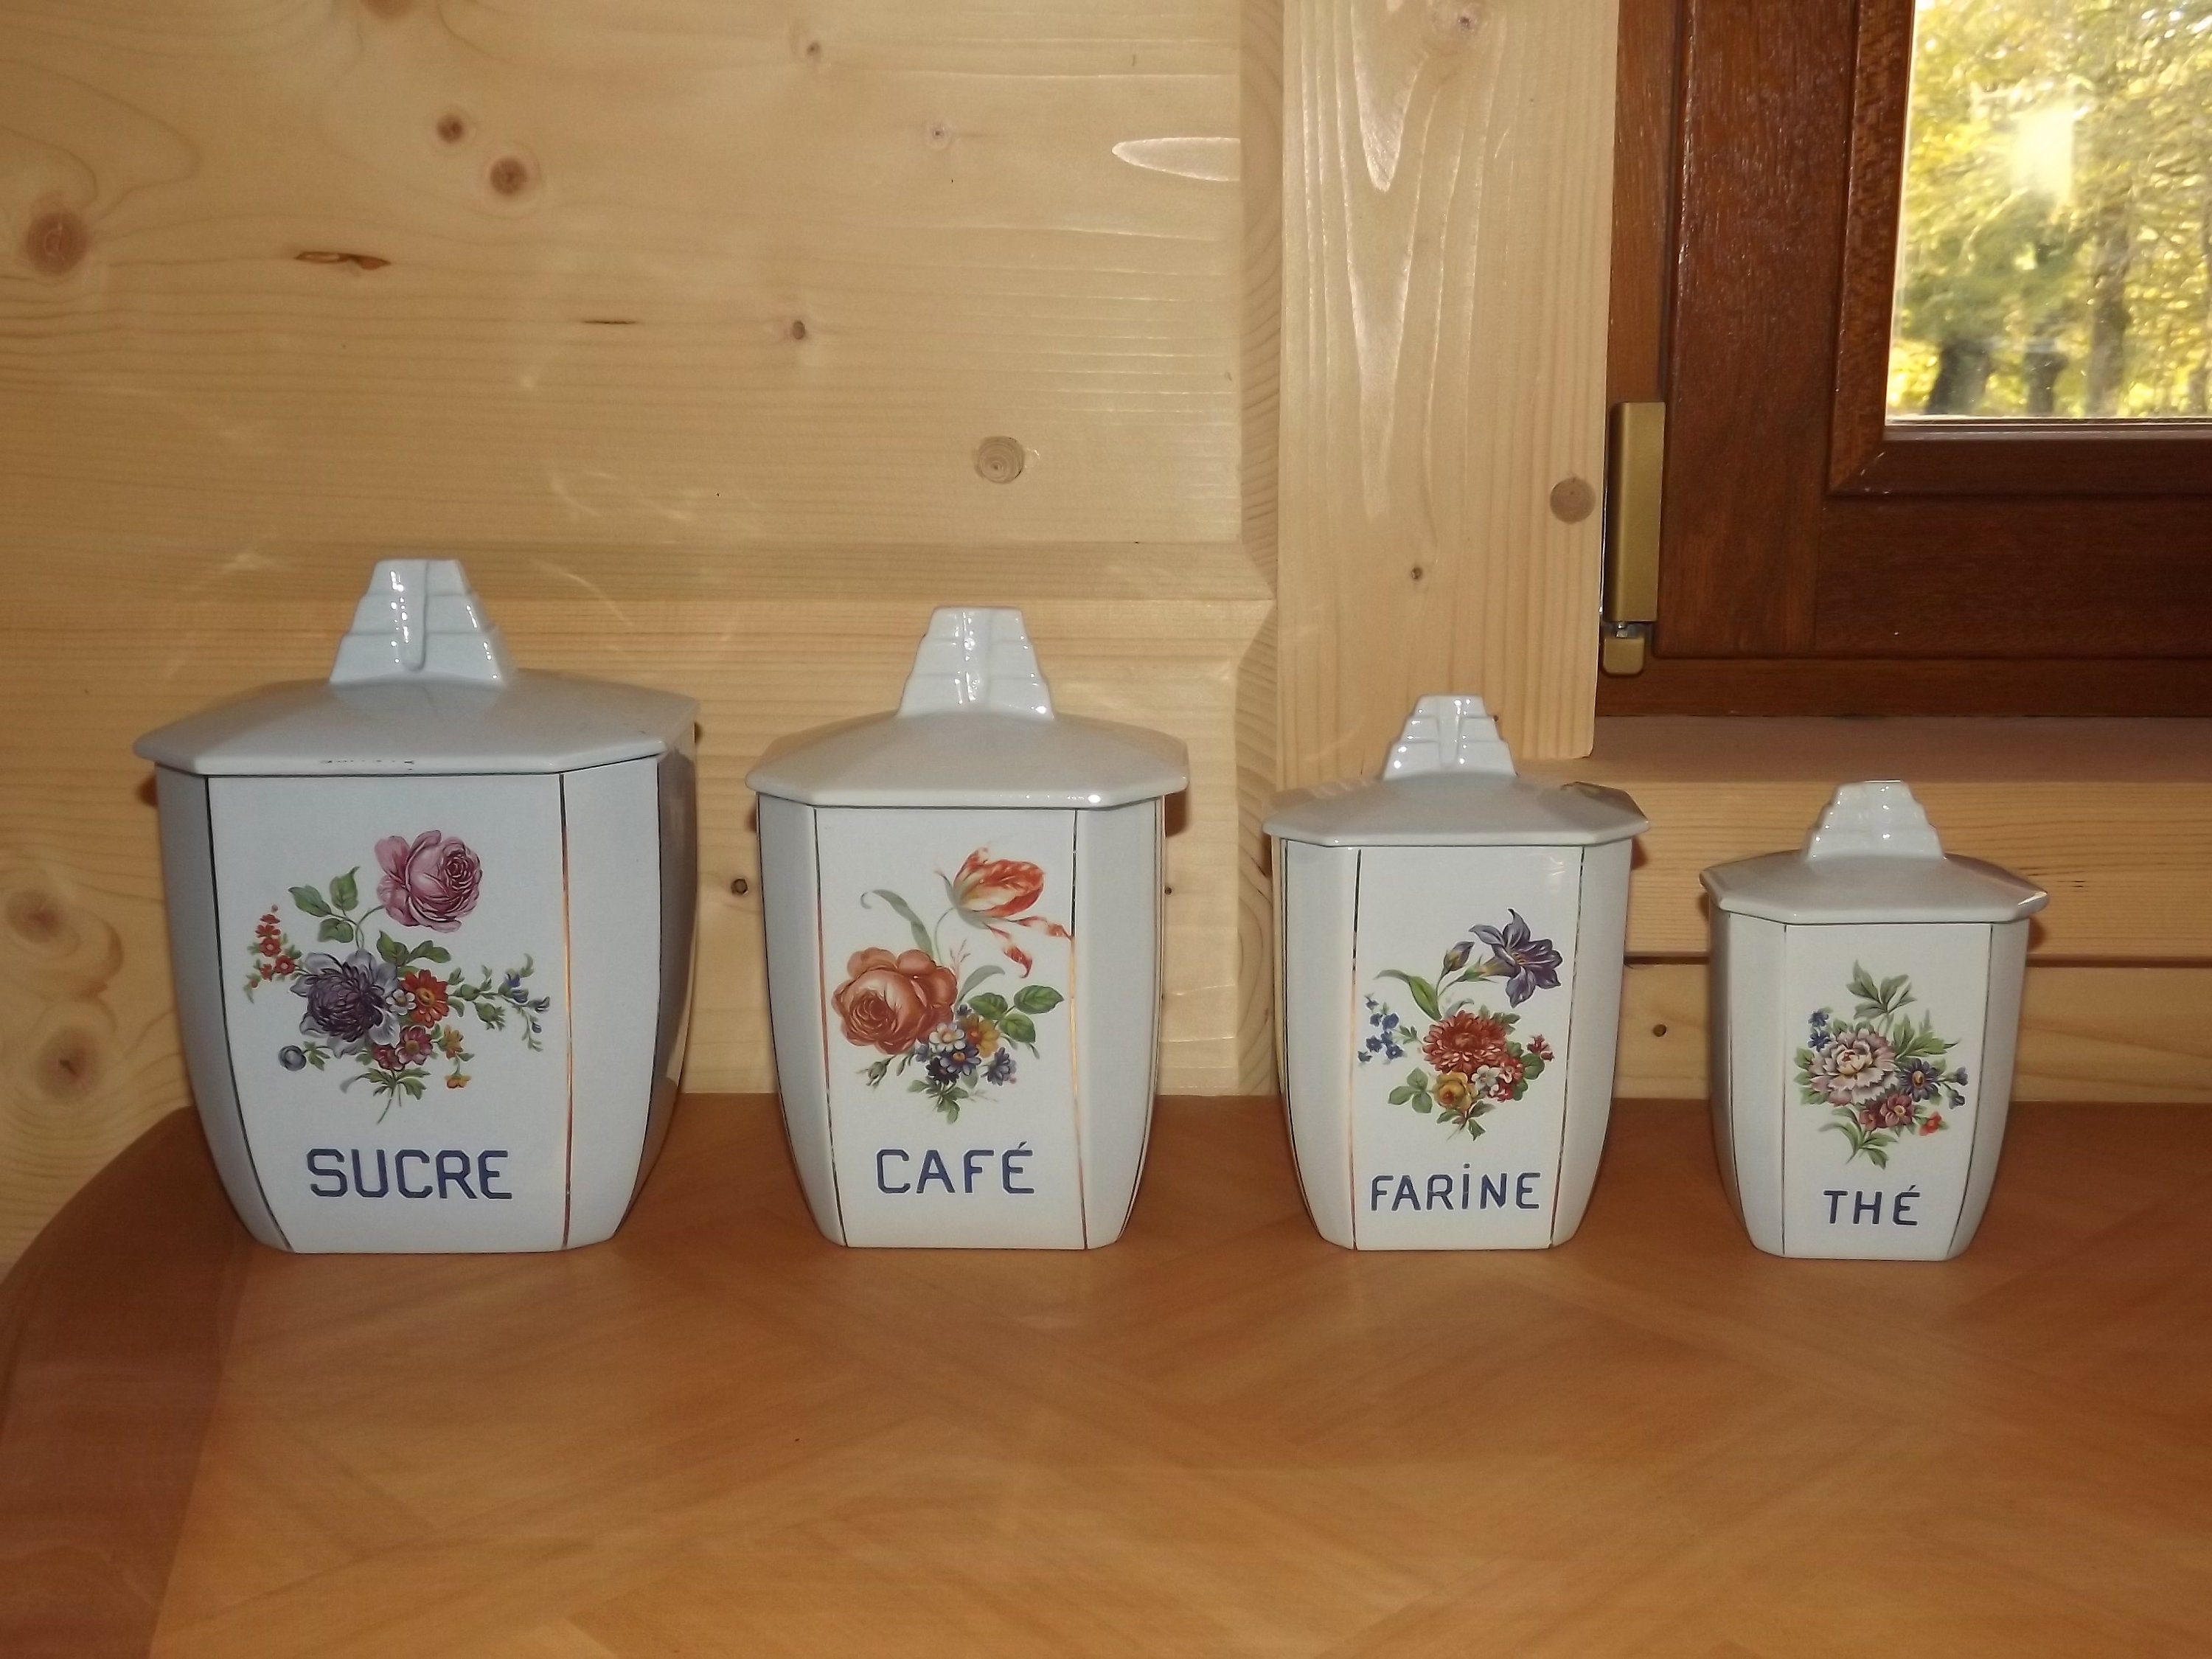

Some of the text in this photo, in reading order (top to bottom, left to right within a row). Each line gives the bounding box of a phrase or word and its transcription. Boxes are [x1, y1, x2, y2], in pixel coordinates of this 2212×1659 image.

[306, 1148, 512, 1200] SUCRE
[876, 1141, 1035, 1194] CAFÉ
[1823, 1184, 1921, 1226] THÉ
